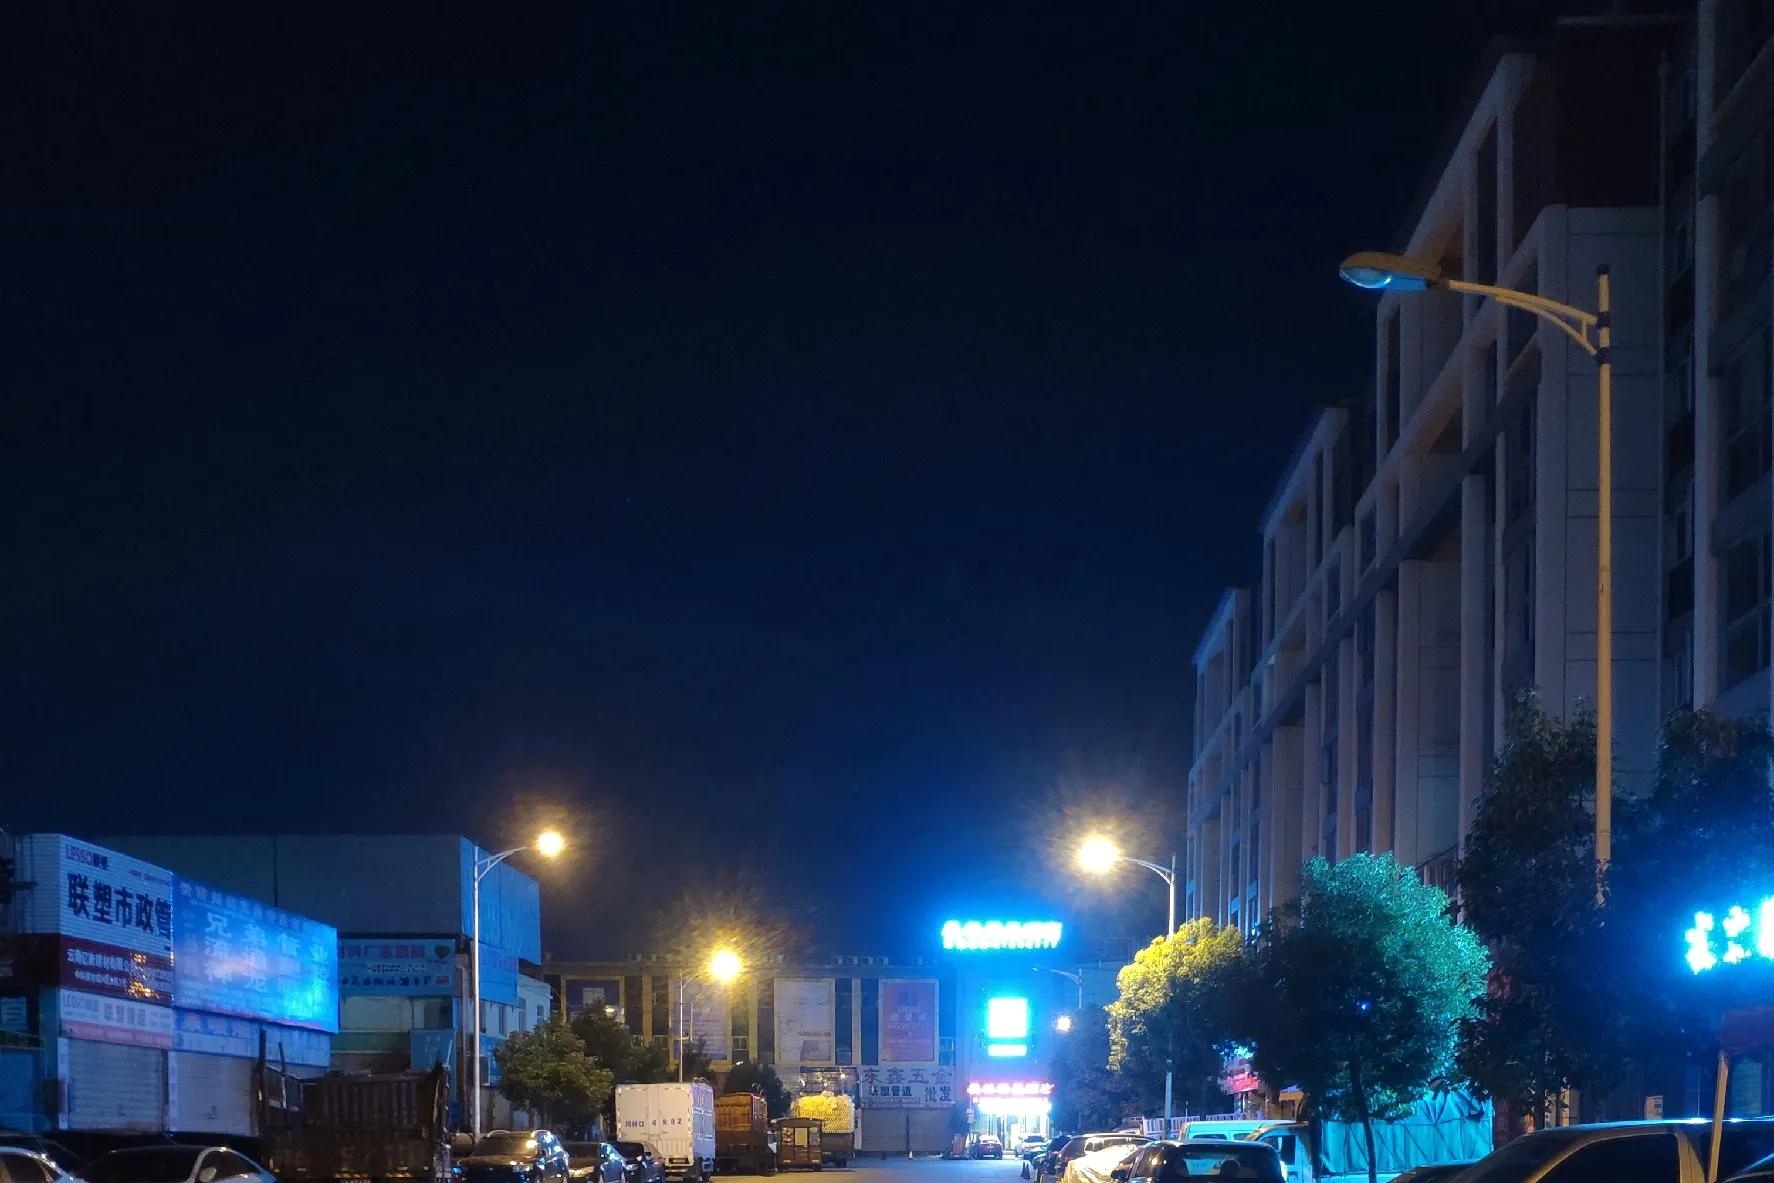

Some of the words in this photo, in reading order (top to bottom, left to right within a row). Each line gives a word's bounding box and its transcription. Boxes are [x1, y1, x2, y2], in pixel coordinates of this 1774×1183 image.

[67, 873, 171, 940] 联塑市政管
[863, 1067, 953, 1085] 东鑫五金
